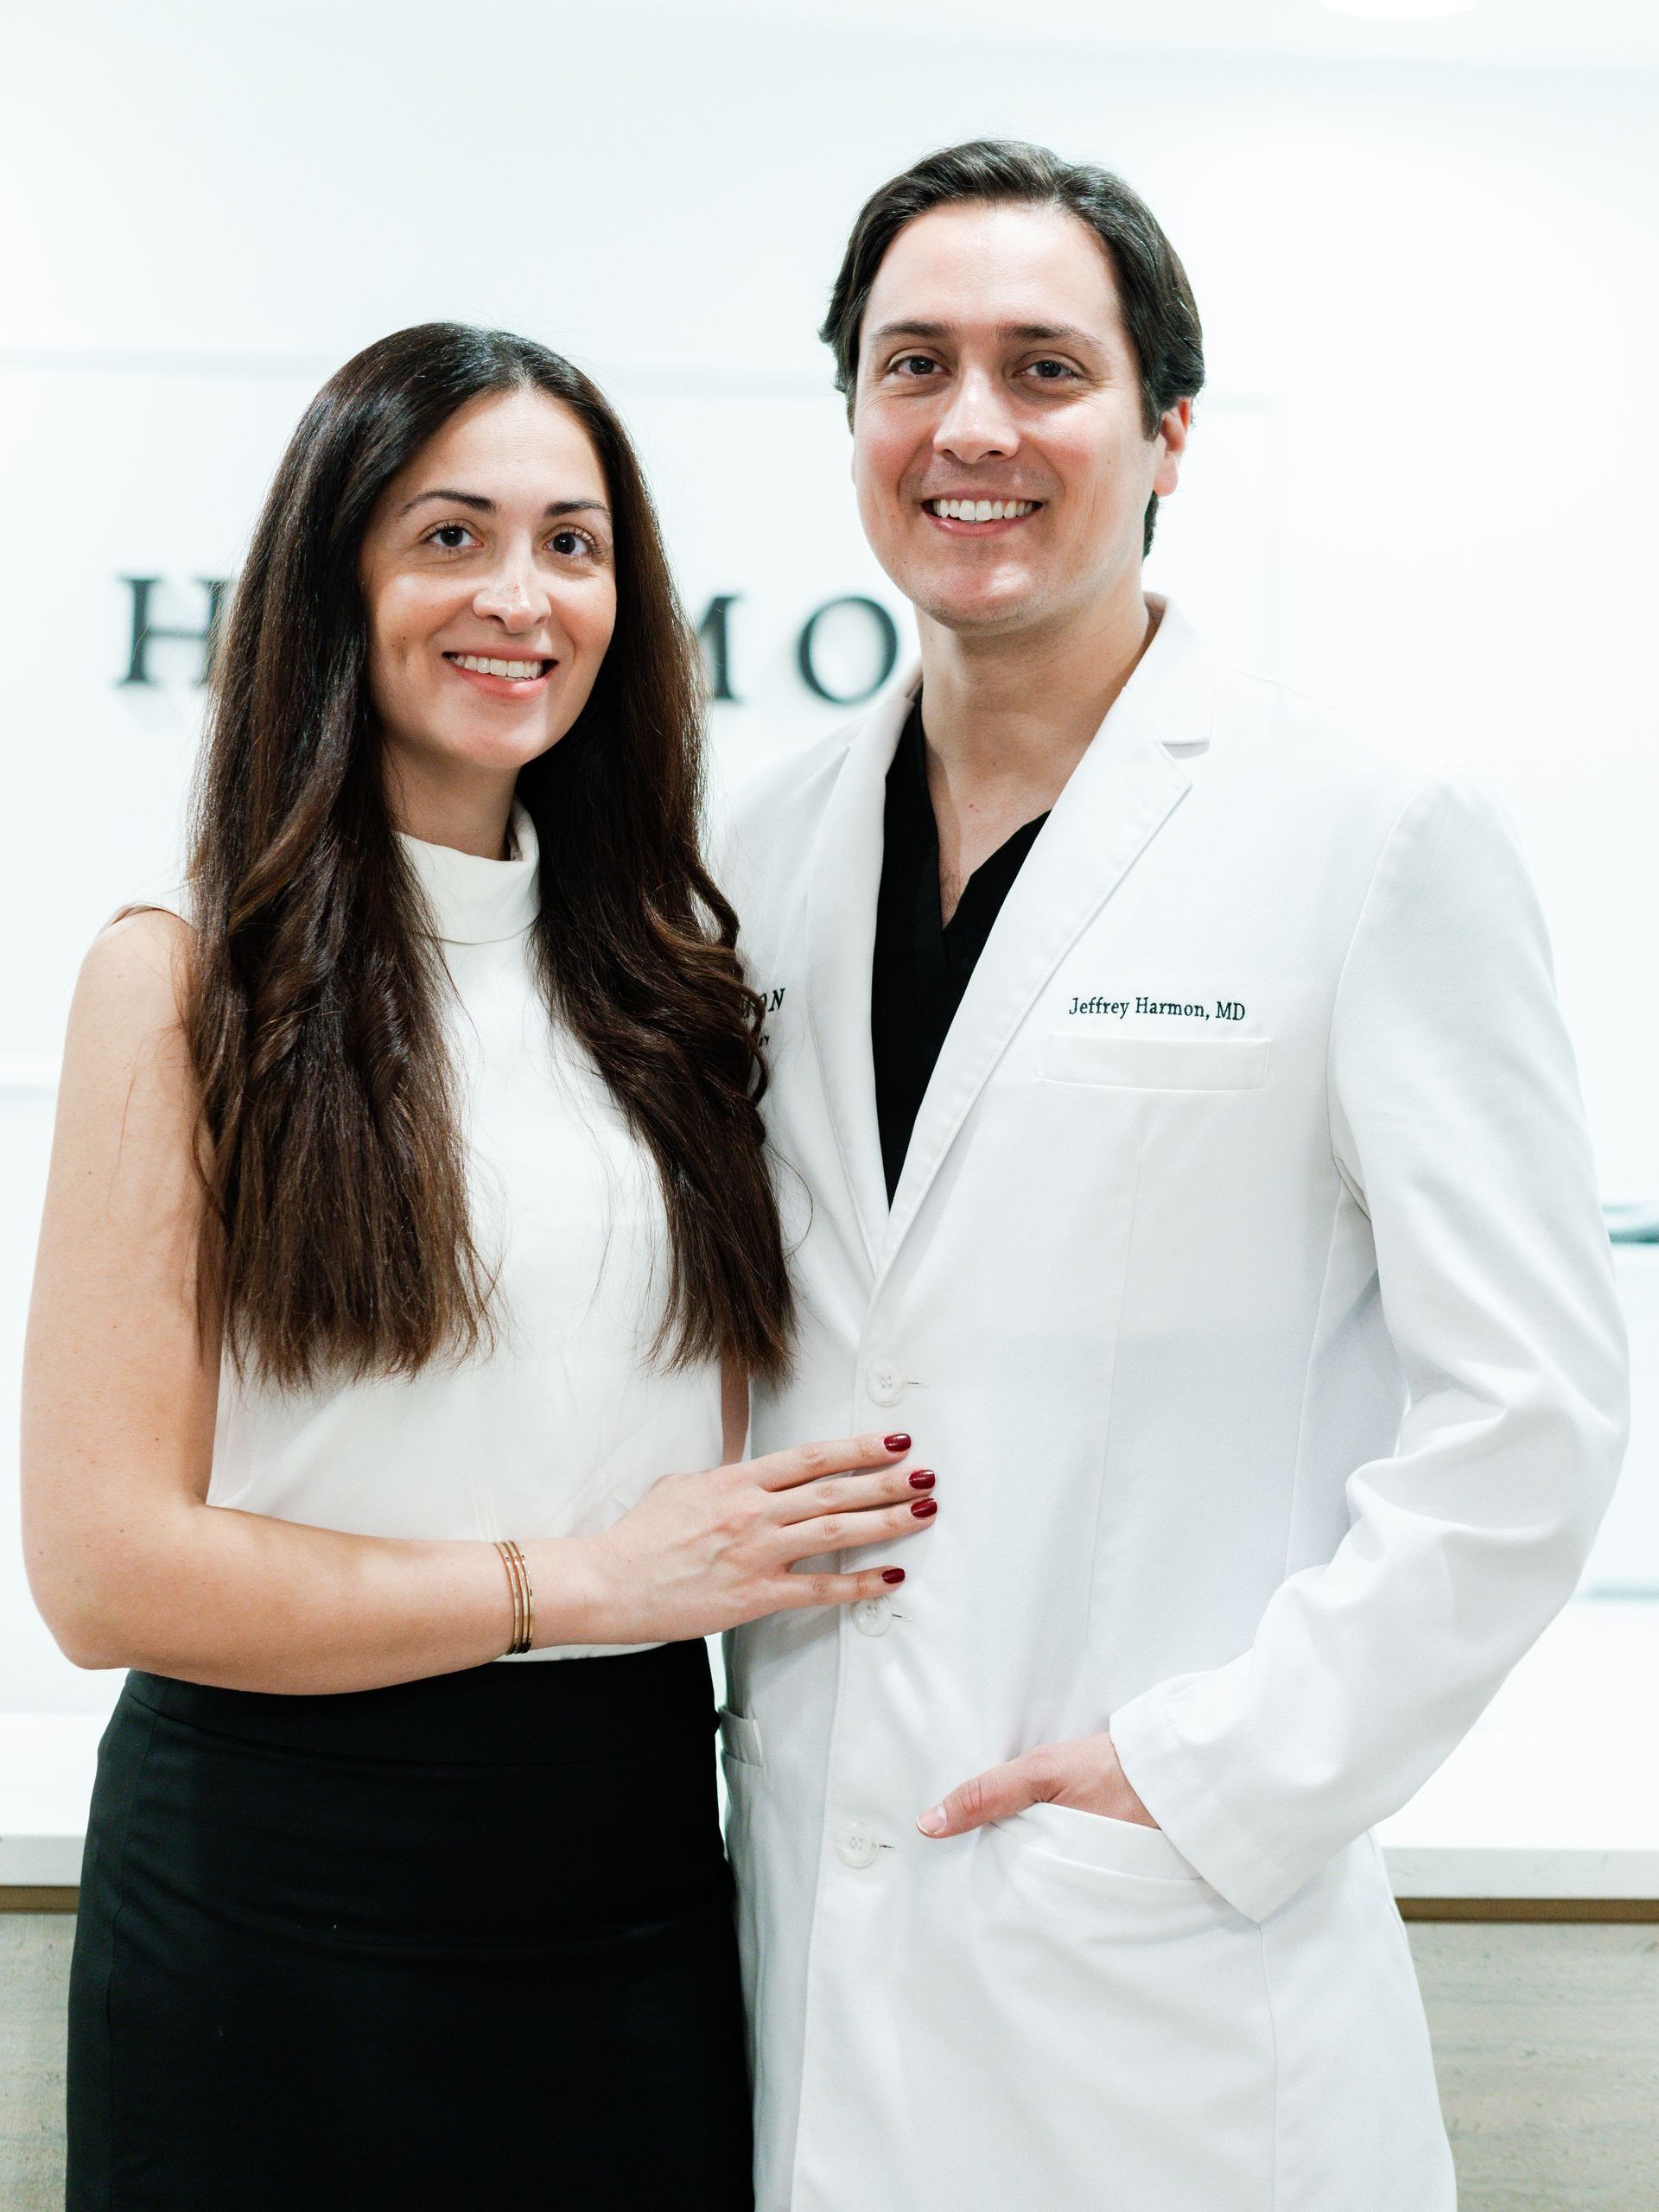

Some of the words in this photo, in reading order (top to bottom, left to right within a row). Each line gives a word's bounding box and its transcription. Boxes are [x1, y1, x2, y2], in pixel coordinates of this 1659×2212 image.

[1068, 996, 1130, 1020] Jeffrey
[1135, 996, 1211, 1021] Harmon,
[1215, 1001, 1246, 1021] MD
